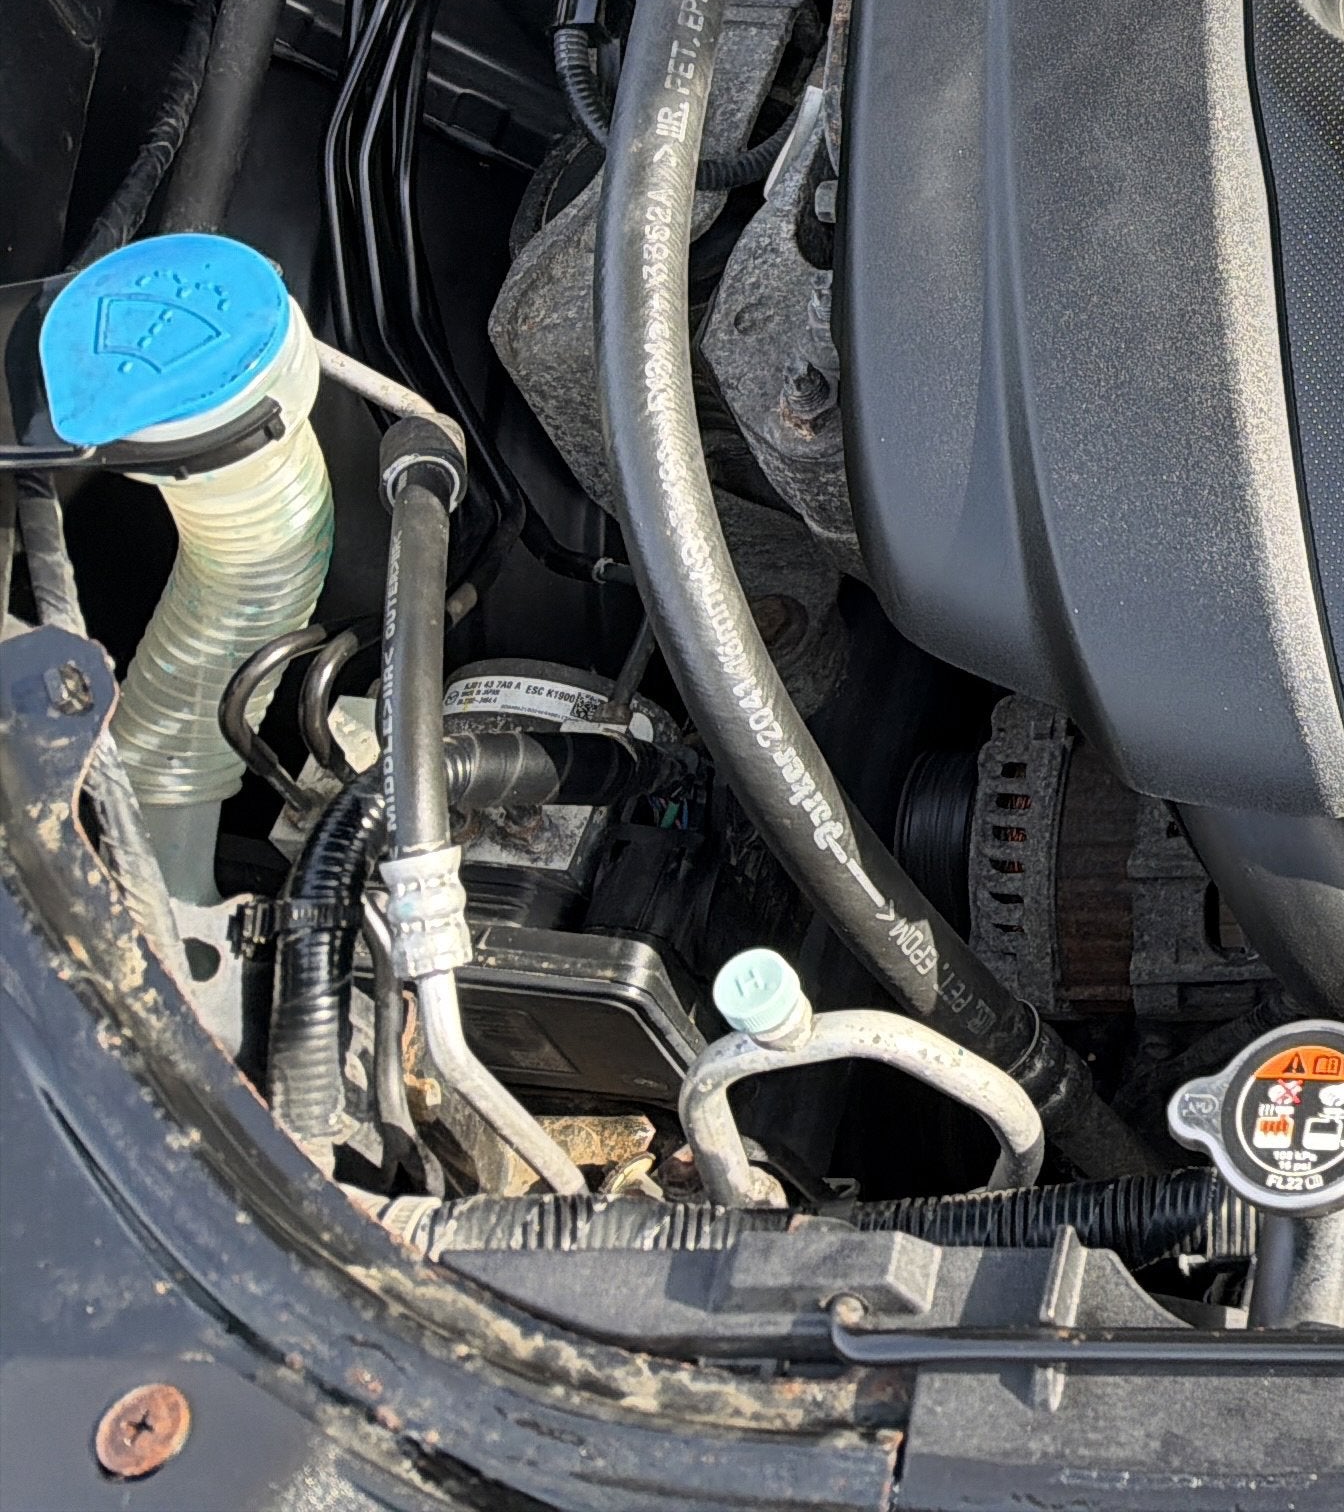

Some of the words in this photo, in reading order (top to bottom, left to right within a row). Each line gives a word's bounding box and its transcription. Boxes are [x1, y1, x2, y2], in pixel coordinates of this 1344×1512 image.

[525, 684, 543, 696] ESC
[732, 680, 784, 748] 2041
[771, 742, 845, 850] Parker
